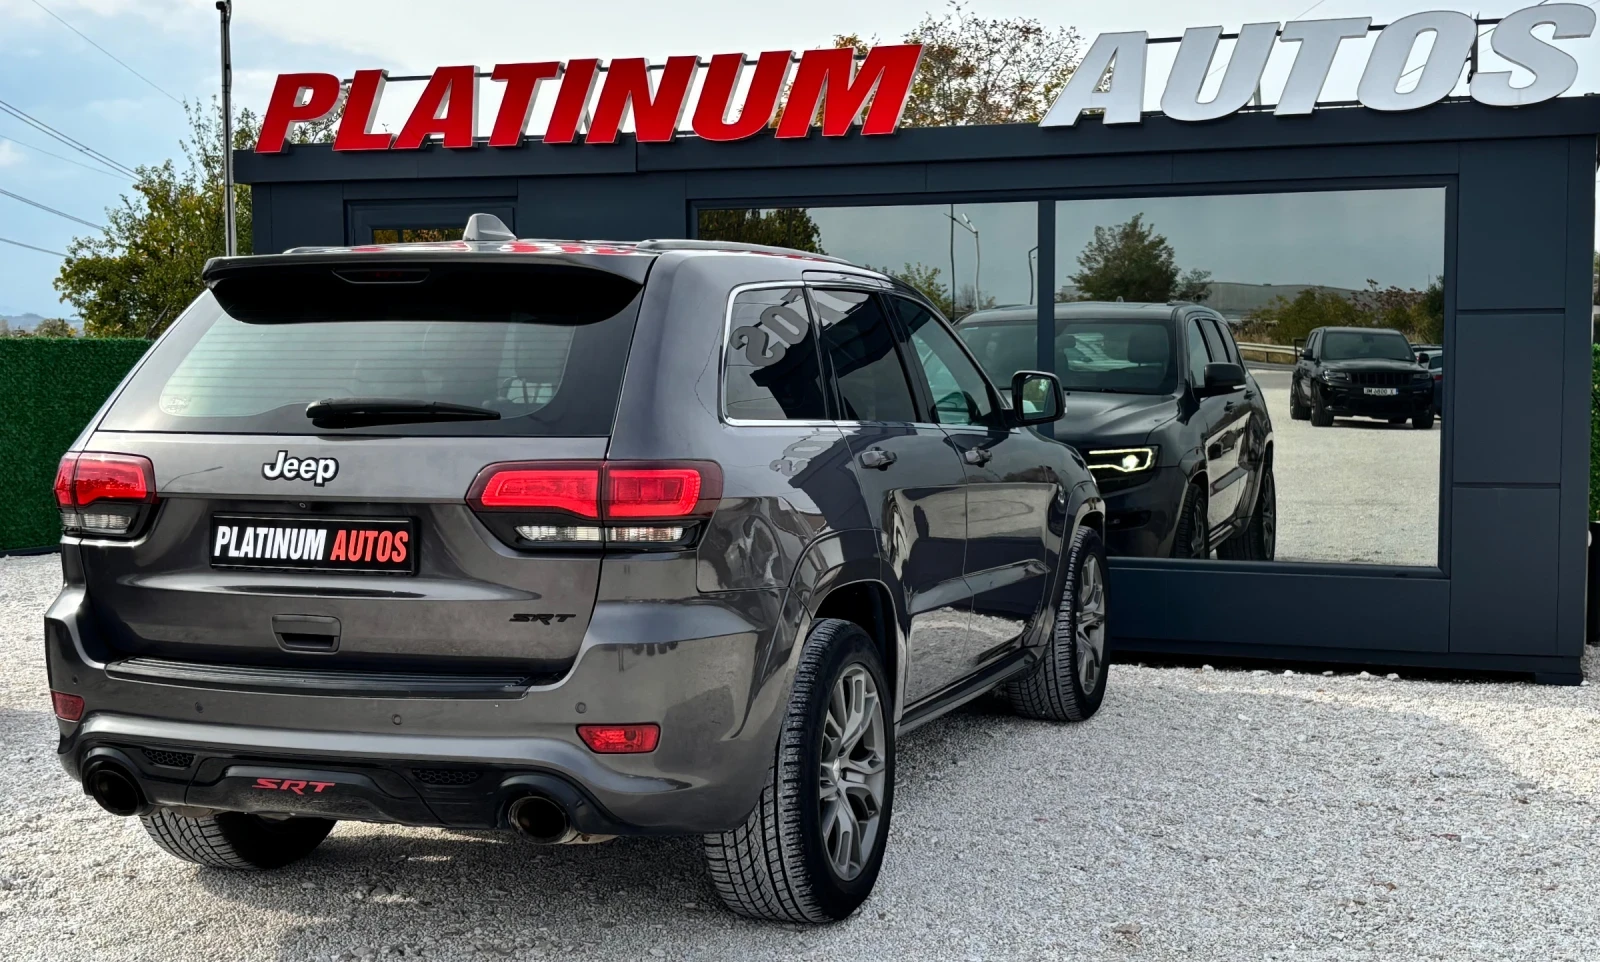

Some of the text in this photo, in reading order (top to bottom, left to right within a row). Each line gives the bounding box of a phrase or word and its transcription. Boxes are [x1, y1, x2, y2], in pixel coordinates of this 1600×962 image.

[254, 2, 1597, 153] PLATINUM AUTOS
[262, 450, 339, 487] Jeep
[213, 525, 409, 563] PLATINUM AUTOS
[509, 613, 577, 626] SRT
[251, 778, 336, 795] SRT
